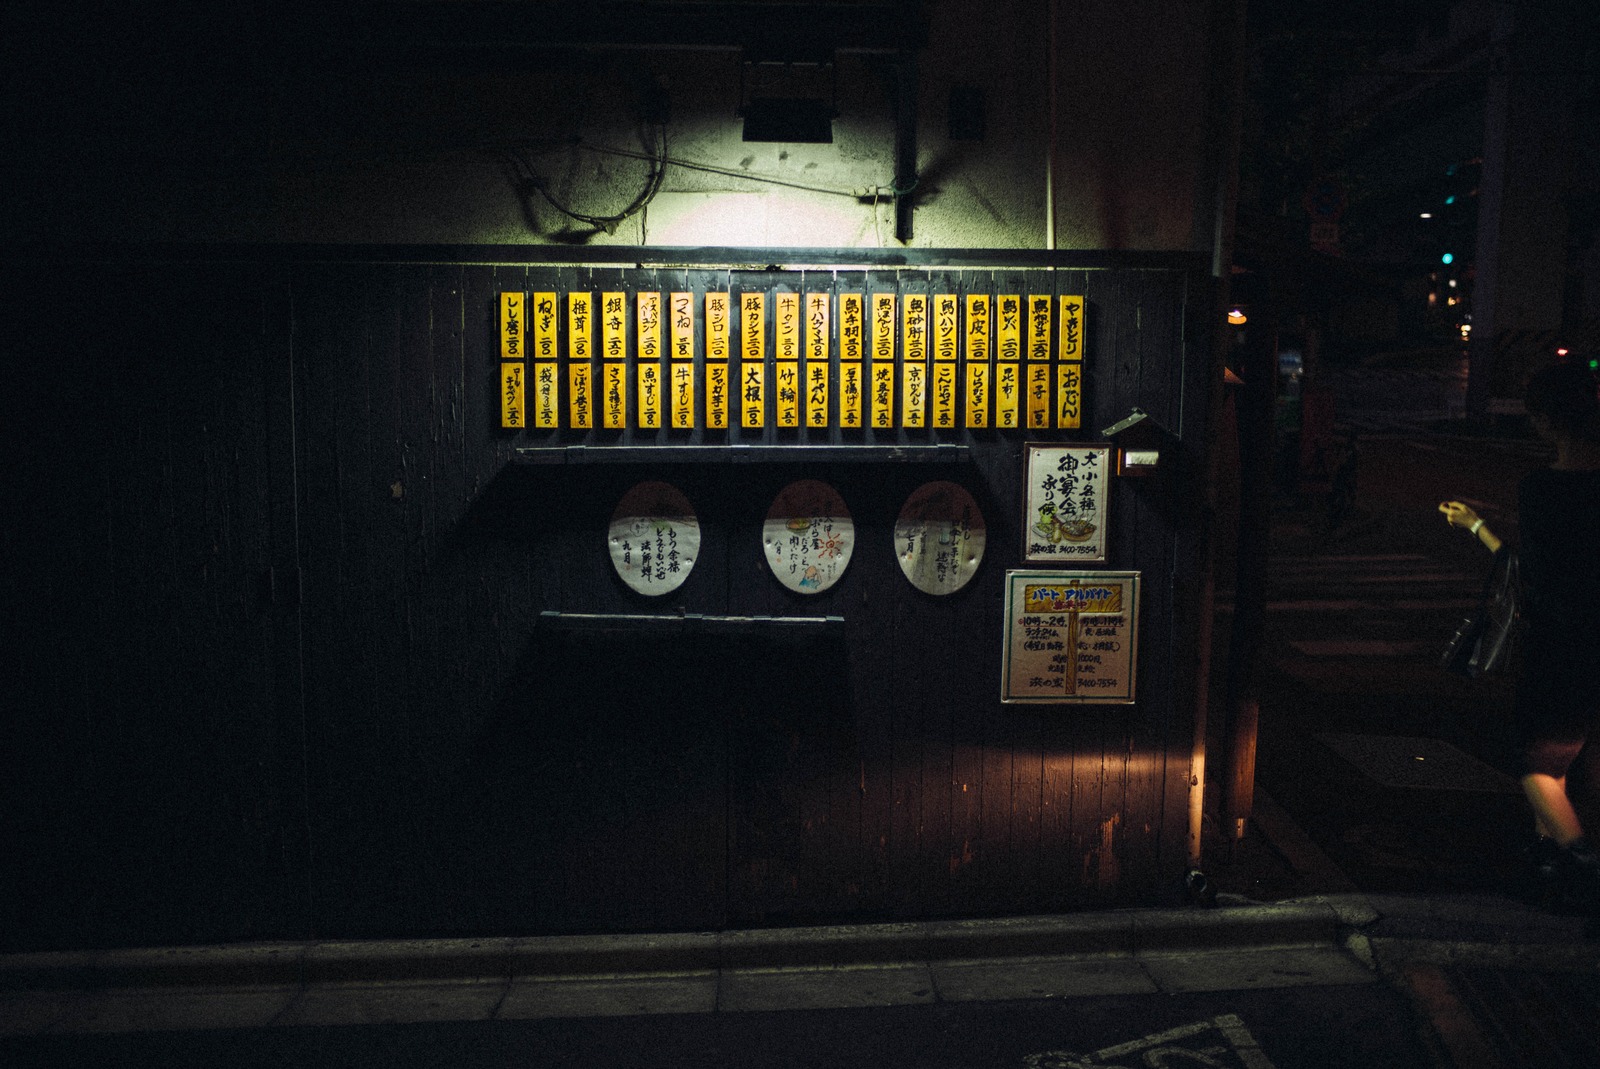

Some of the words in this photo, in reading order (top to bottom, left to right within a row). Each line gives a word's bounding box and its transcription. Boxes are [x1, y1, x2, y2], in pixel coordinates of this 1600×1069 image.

[506, 297, 519, 335] しし唐
[538, 298, 554, 332] ねぎ
[572, 299, 587, 332] 椎茸
[606, 298, 622, 330] 銀杏
[641, 303, 650, 333] ベーコン
[650, 296, 658, 329] アスパラ
[676, 299, 690, 327] つくね
[710, 300, 724, 331] 豚シロ
[745, 297, 761, 337] 豚カシラ
[781, 299, 794, 334] 牛タン
[844, 298, 859, 337] 鳥手羽
[907, 299, 924, 339] 鳥砂肝
[940, 300, 954, 337] 鳥ハツ
[970, 300, 986, 335] 鳥皮
[1032, 299, 1048, 337] 鳥ねぎま
[1065, 303, 1080, 354] やきとり
[506, 377, 515, 405] キャベツ
[513, 368, 521, 387] ロール
[573, 368, 587, 408] ごぼう巻
[609, 368, 621, 409] さつま揚げ
[643, 368, 656, 405] 魚すじ
[676, 368, 690, 405] 牛すじ
[712, 369, 725, 407] ジャガ芋
[745, 368, 761, 402] 大根
[780, 369, 796, 402] 竹輪
[811, 368, 825, 404] 半ぺん
[875, 369, 890, 405] 焼豆腐
[909, 367, 921, 405] 京がんも
[938, 369, 951, 406] こんにゃく
[972, 368, 983, 406] しらたき
[1002, 368, 1014, 399] 昆布
[1062, 370, 1078, 418] おでん
[1038, 474, 1058, 516] 承り候
[1057, 453, 1079, 516] 御宴会
[622, 540, 632, 564] 九月
[774, 540, 783, 555] 八月
[906, 534, 915, 552] 七月
[1059, 545, 1097, 554] 3400-7554
[1032, 588, 1059, 600] パート
[1064, 588, 1113, 600] アルバイト
[1077, 678, 1118, 688] 3400-7554
